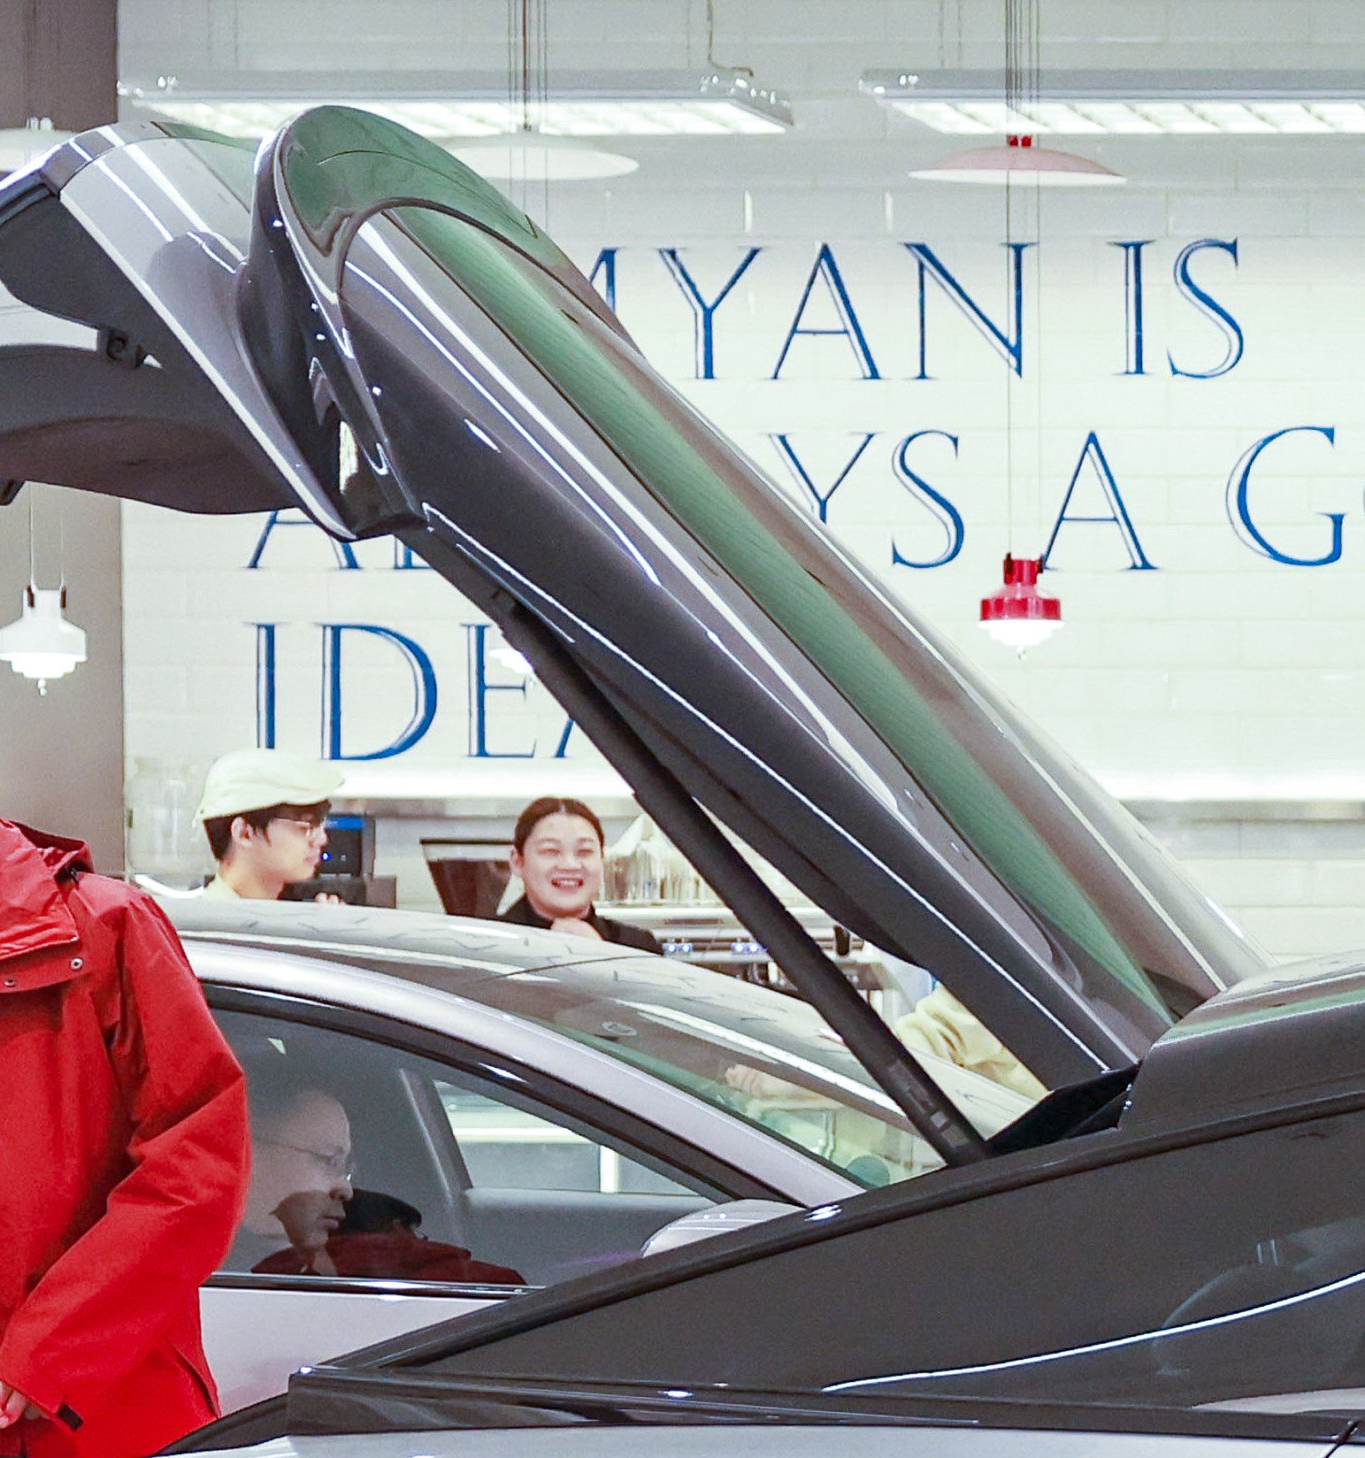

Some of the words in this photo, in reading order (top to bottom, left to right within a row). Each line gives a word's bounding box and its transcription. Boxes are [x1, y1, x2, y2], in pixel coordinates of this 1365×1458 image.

[588, 240, 1040, 381] YAN
[1105, 238, 1246, 380] IS
[1039, 430, 1161, 570] A
[243, 621, 575, 761] IDE
